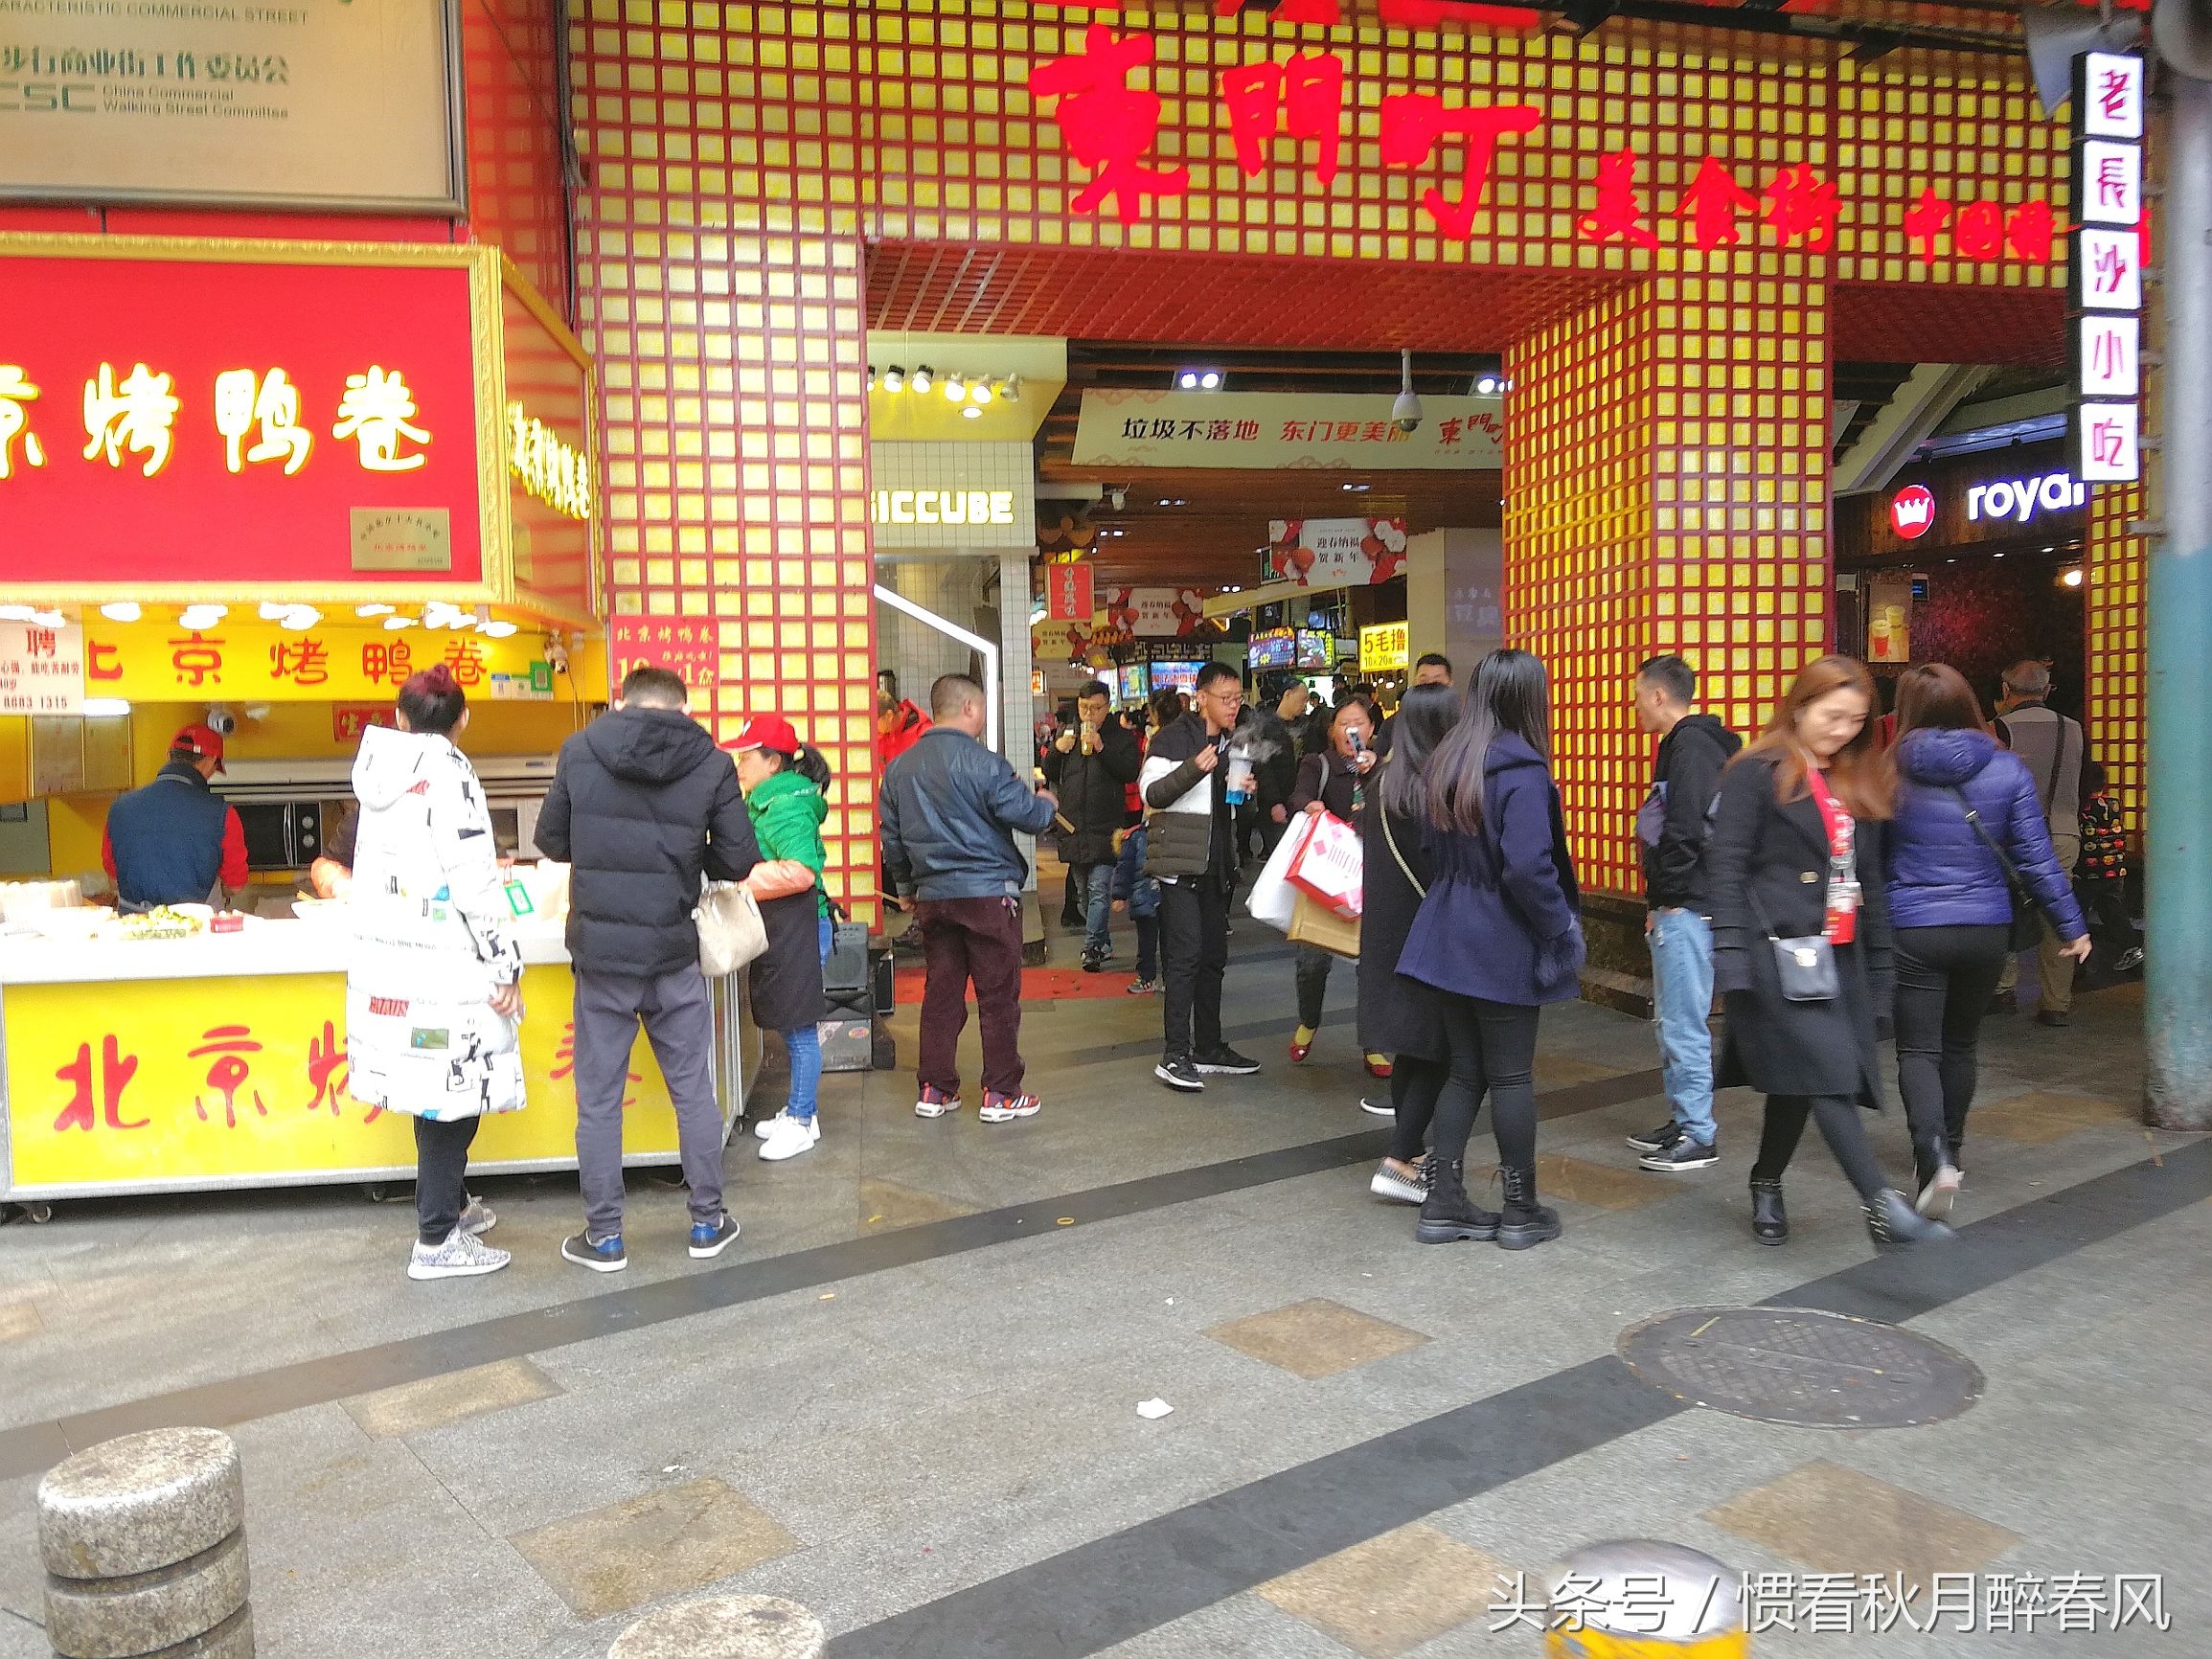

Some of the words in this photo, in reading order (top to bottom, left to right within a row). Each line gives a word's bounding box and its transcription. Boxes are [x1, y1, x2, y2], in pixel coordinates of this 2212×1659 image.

[127, 3, 239, 22] COMMERCIAL
[247, 8, 308, 25] STREET
[103, 84, 145, 100] China
[148, 85, 234, 101] Commercial
[103, 100, 162, 116] Walking
[165, 102, 208, 115] Street
[213, 103, 289, 119] Committee
[1121, 418, 1260, 442] 垃圾不落地
[870, 489, 1015, 525] ICCUBE
[1316, 536, 1360, 549] 迎春纳福
